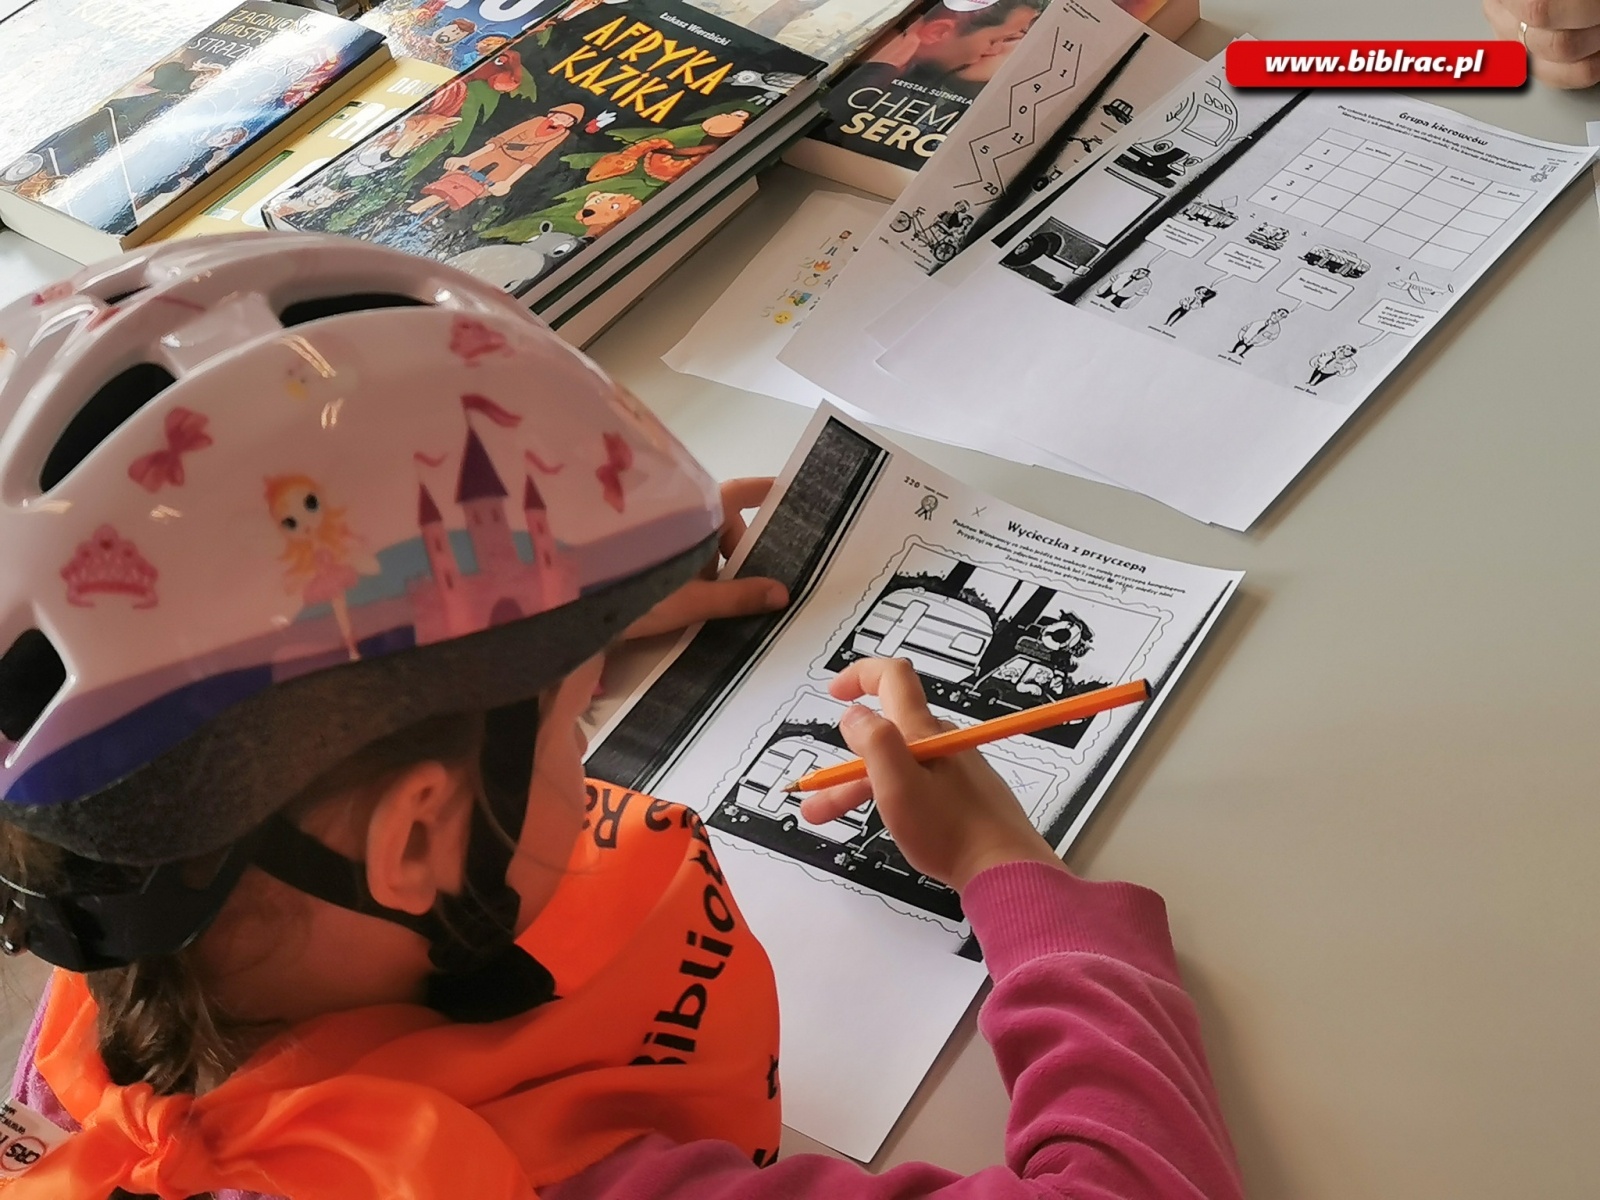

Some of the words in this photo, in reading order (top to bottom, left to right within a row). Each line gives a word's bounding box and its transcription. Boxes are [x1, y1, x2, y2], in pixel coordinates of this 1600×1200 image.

[212, 22, 273, 43] MIASTA
[659, 12, 689, 30] Łukasz
[688, 23, 732, 46] Wierzbicki
[583, 15, 734, 96] AFRYKA
[1062, 40, 1075, 52] 11
[548, 44, 686, 124] KAZIKA
[1060, 69, 1068, 78] 1
[891, 78, 927, 93] KRYSTAL
[1033, 83, 1042, 93] 9
[847, 87, 960, 134] CHEM
[840, 112, 948, 158] SERC
[1011, 133, 1024, 145] 11
[1399, 112, 1429, 128] Grupa
[1431, 122, 1489, 147] kierowców
[980, 145, 990, 155] 5
[983, 182, 999, 195] 20
[1007, 520, 1069, 550] Wycieczka
[1071, 545, 1079, 553] z
[1080, 548, 1147, 574] przyczepą
